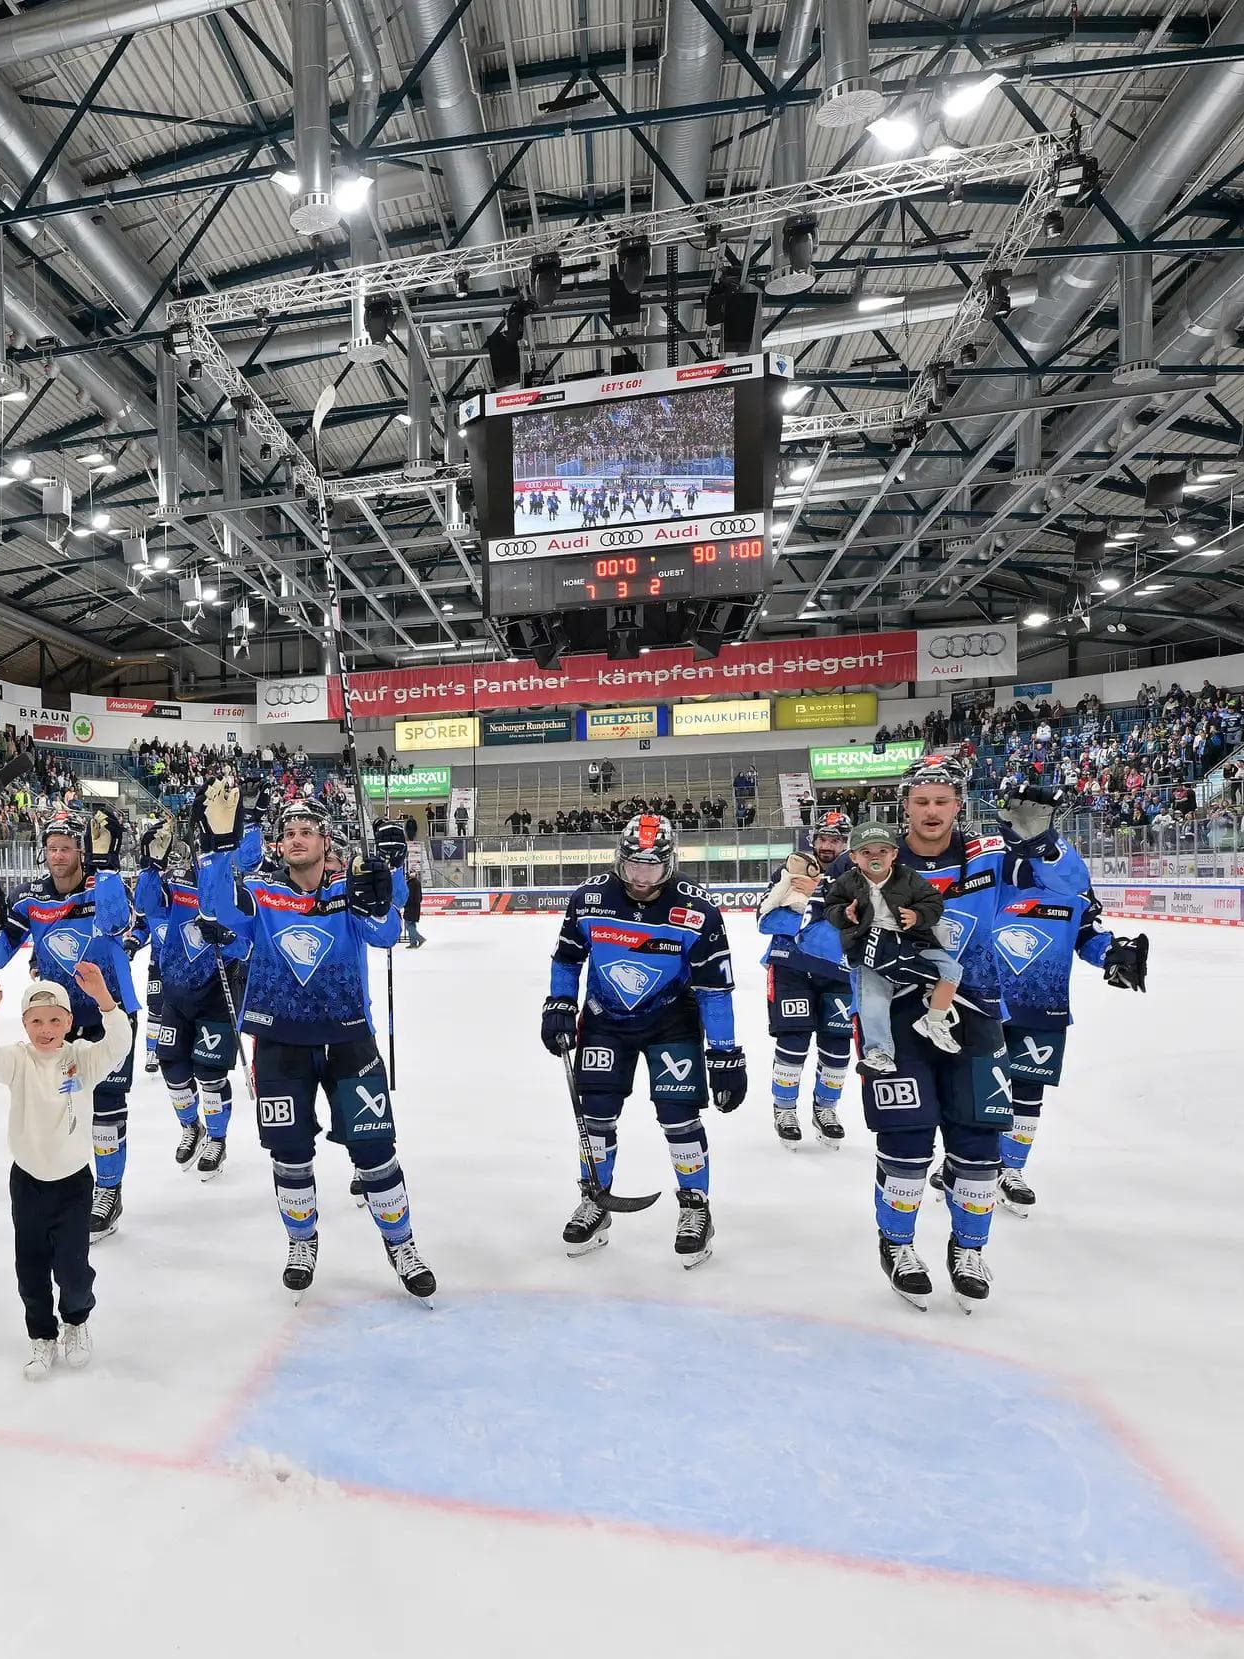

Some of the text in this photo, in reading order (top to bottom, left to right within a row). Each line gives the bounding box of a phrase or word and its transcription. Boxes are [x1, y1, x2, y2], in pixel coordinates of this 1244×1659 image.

[732, 366, 751, 374] SATURN
[601, 379, 642, 393] LET'S GO!
[655, 526, 699, 540] Audi
[547, 536, 589, 551] Audi
[693, 541, 762, 563] 90 1:00
[658, 569, 684, 577] GUEST
[586, 585, 596, 599] 7
[618, 582, 628, 598] 3
[650, 580, 661, 595] 2
[348, 686, 388, 703] Auf
[473, 676, 569, 696] Panther
[598, 664, 714, 688] kämpfen
[723, 657, 775, 678] und
[783, 650, 884, 676] siegen!
[931, 664, 964, 675] Audi
[20, 708, 69, 722] BRAUN
[213, 708, 244, 717] LET'S GO!
[266, 711, 291, 720] Audi
[593, 713, 651, 724] LIFE PARK
[676, 711, 769, 725] DONAUKURIER
[489, 719, 566, 734] Neuburger Rundschau
[964, 876, 991, 890] SATURN
[590, 907, 616, 915] Bayern
[543, 1001, 578, 1014] AUER
[785, 1001, 806, 1015] DB
[194, 1049, 221, 1059] BAUER
[586, 1050, 610, 1069] DB
[359, 1056, 381, 1077] BAUER
[1010, 1063, 1054, 1076] BAUER
[655, 1084, 696, 1093] BAUER
[878, 1084, 914, 1106] DB
[262, 1101, 289, 1123] DB
[984, 1106, 1014, 1115] BAU
[354, 1122, 392, 1133] BAUER
